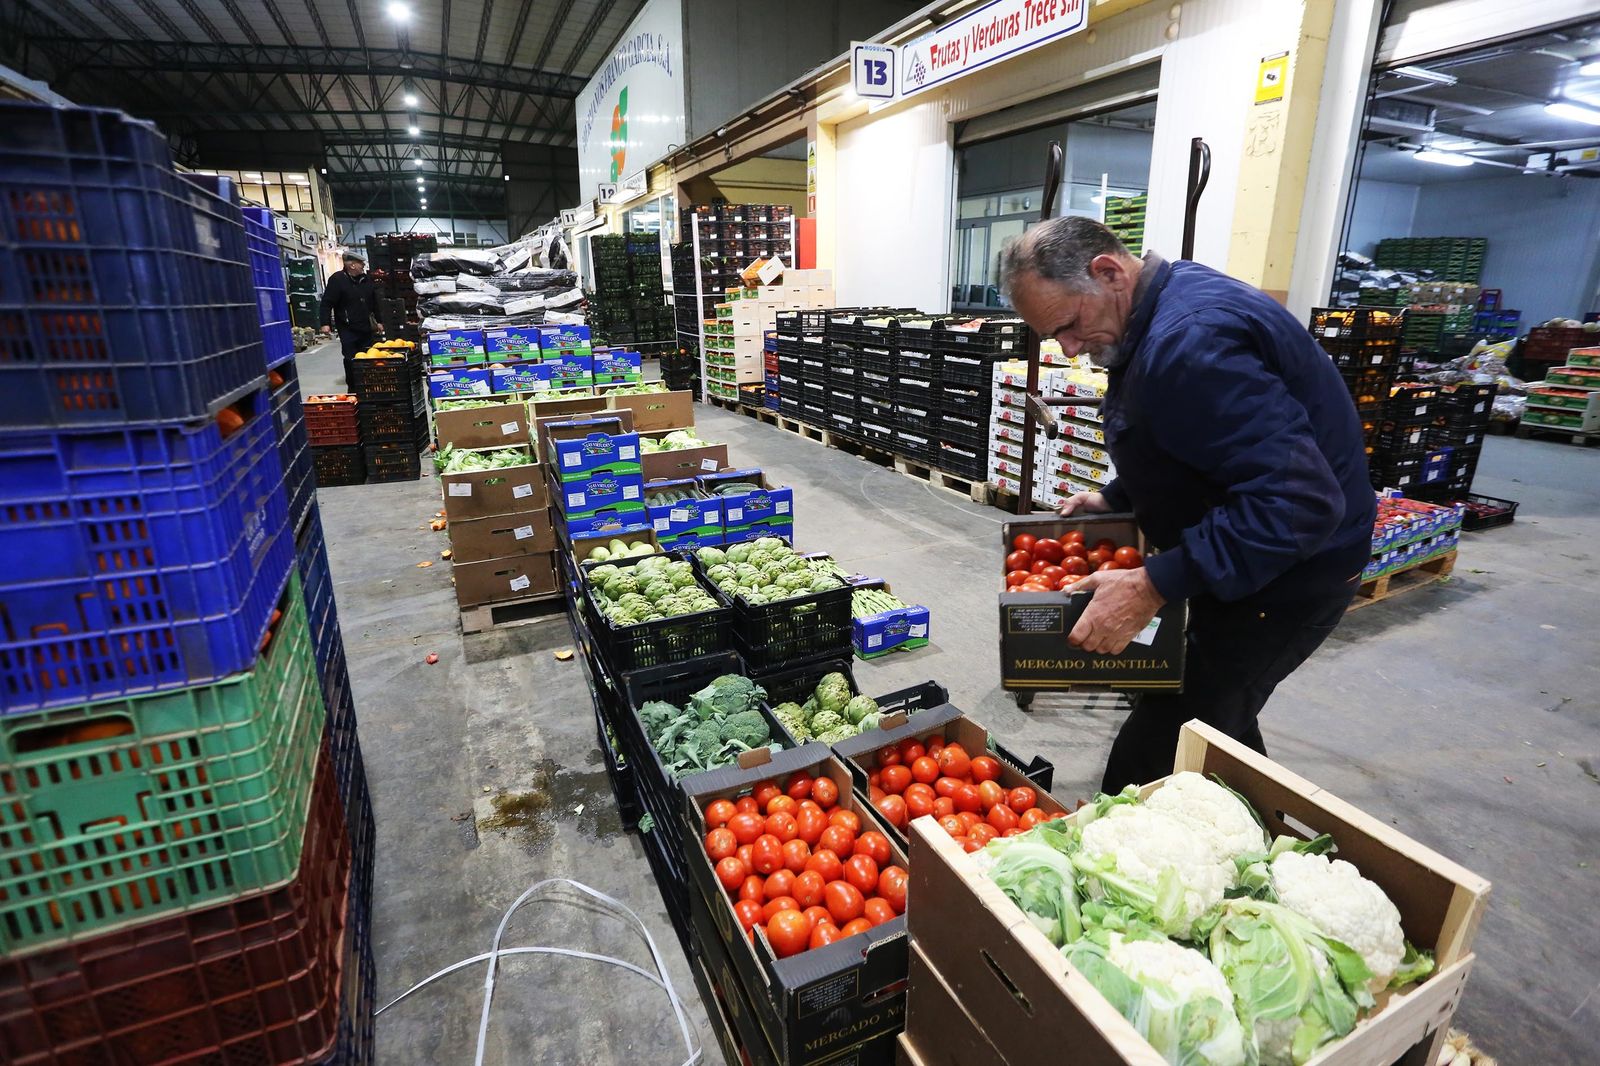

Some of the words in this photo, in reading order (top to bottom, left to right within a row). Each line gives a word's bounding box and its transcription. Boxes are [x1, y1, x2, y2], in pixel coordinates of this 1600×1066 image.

[930, 40, 960, 71] Frutas
[963, 35, 970, 66] y
[972, 11, 1020, 53] Verduras
[1024, 0, 1057, 31] Trece
[864, 59, 887, 85] 13
[281, 222, 288, 230] 3
[565, 214, 575, 222] 11
[1015, 659, 1085, 669] MERCADO
[1092, 659, 1169, 669] MONTILLA
[804, 1014, 880, 1053] MERCADO
